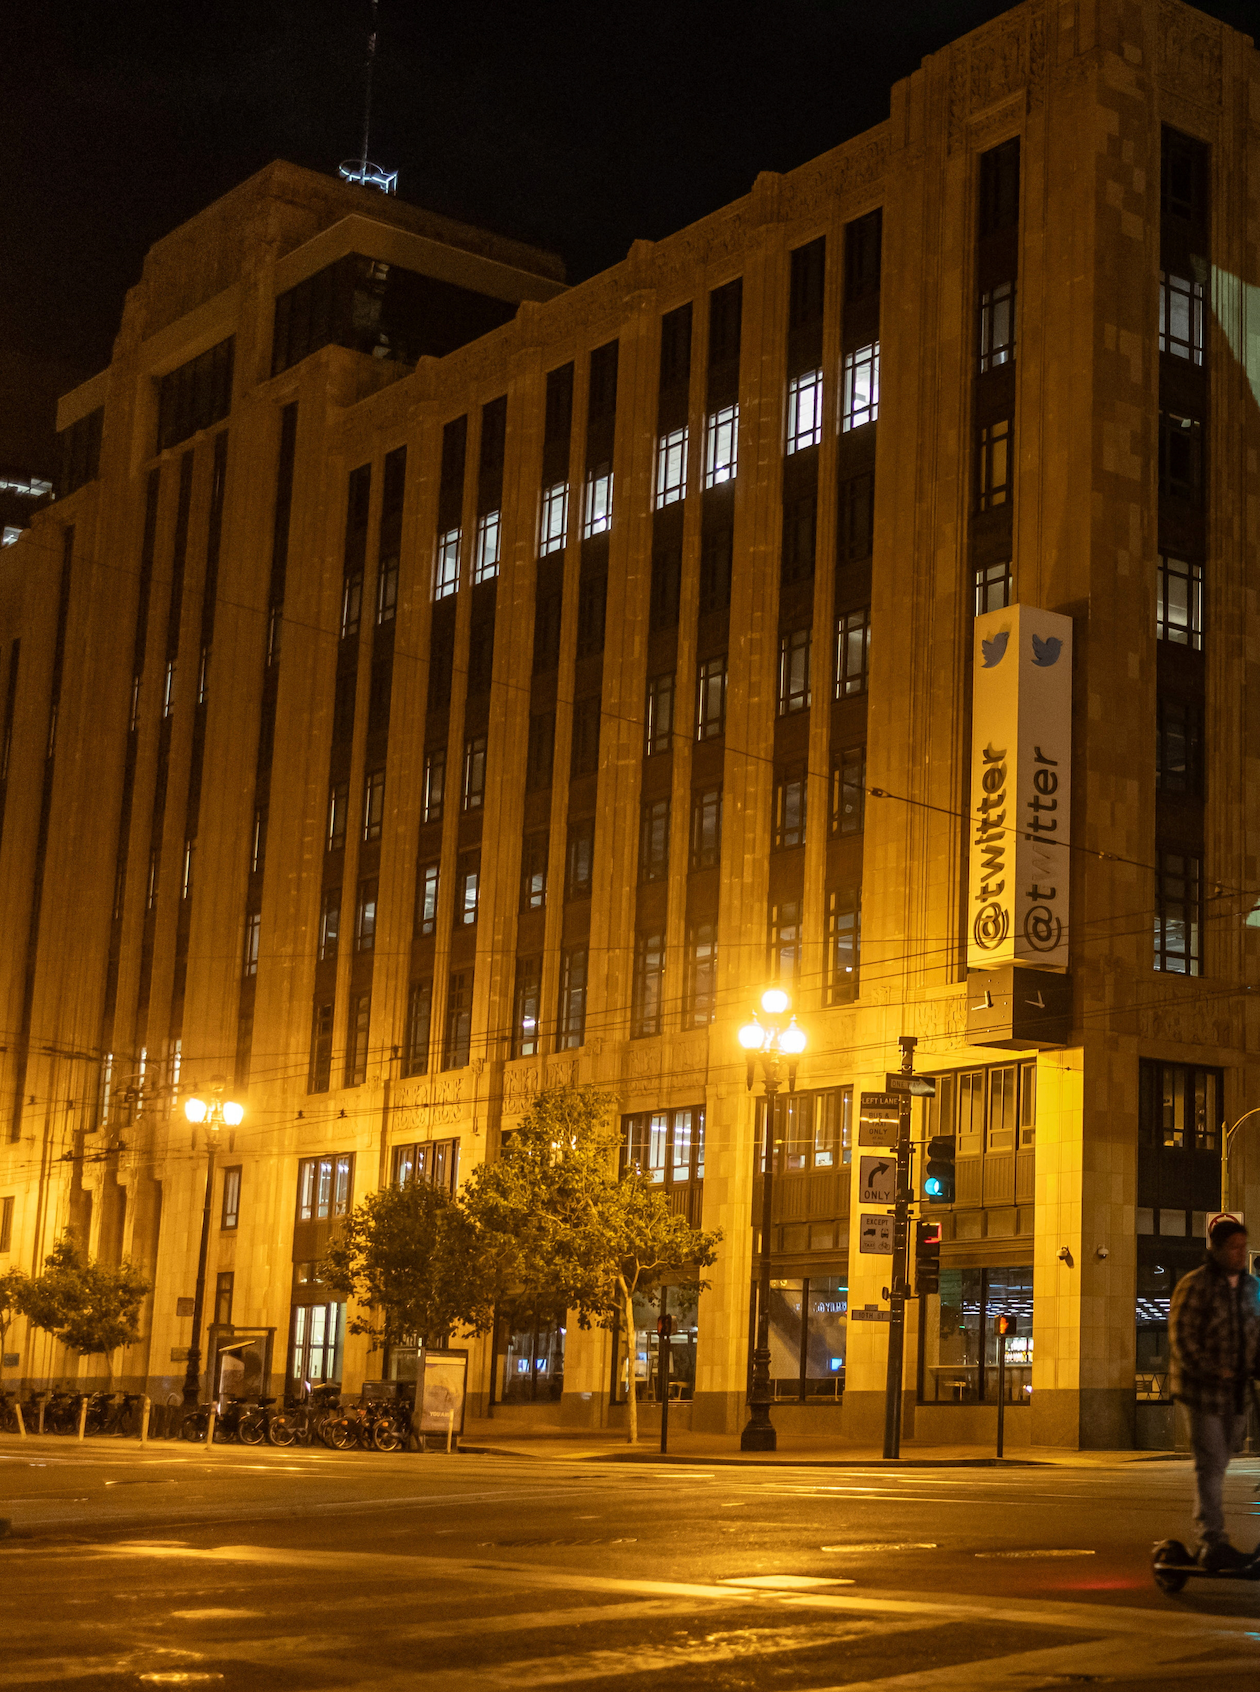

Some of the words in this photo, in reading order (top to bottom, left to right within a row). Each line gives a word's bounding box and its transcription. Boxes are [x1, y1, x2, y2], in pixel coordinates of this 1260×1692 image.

[891, 1080, 904, 1088] ONE
[880, 1097, 898, 1105] LANE
[864, 1190, 890, 1200] ONLY
[866, 1218, 888, 1226] EXCEPT
